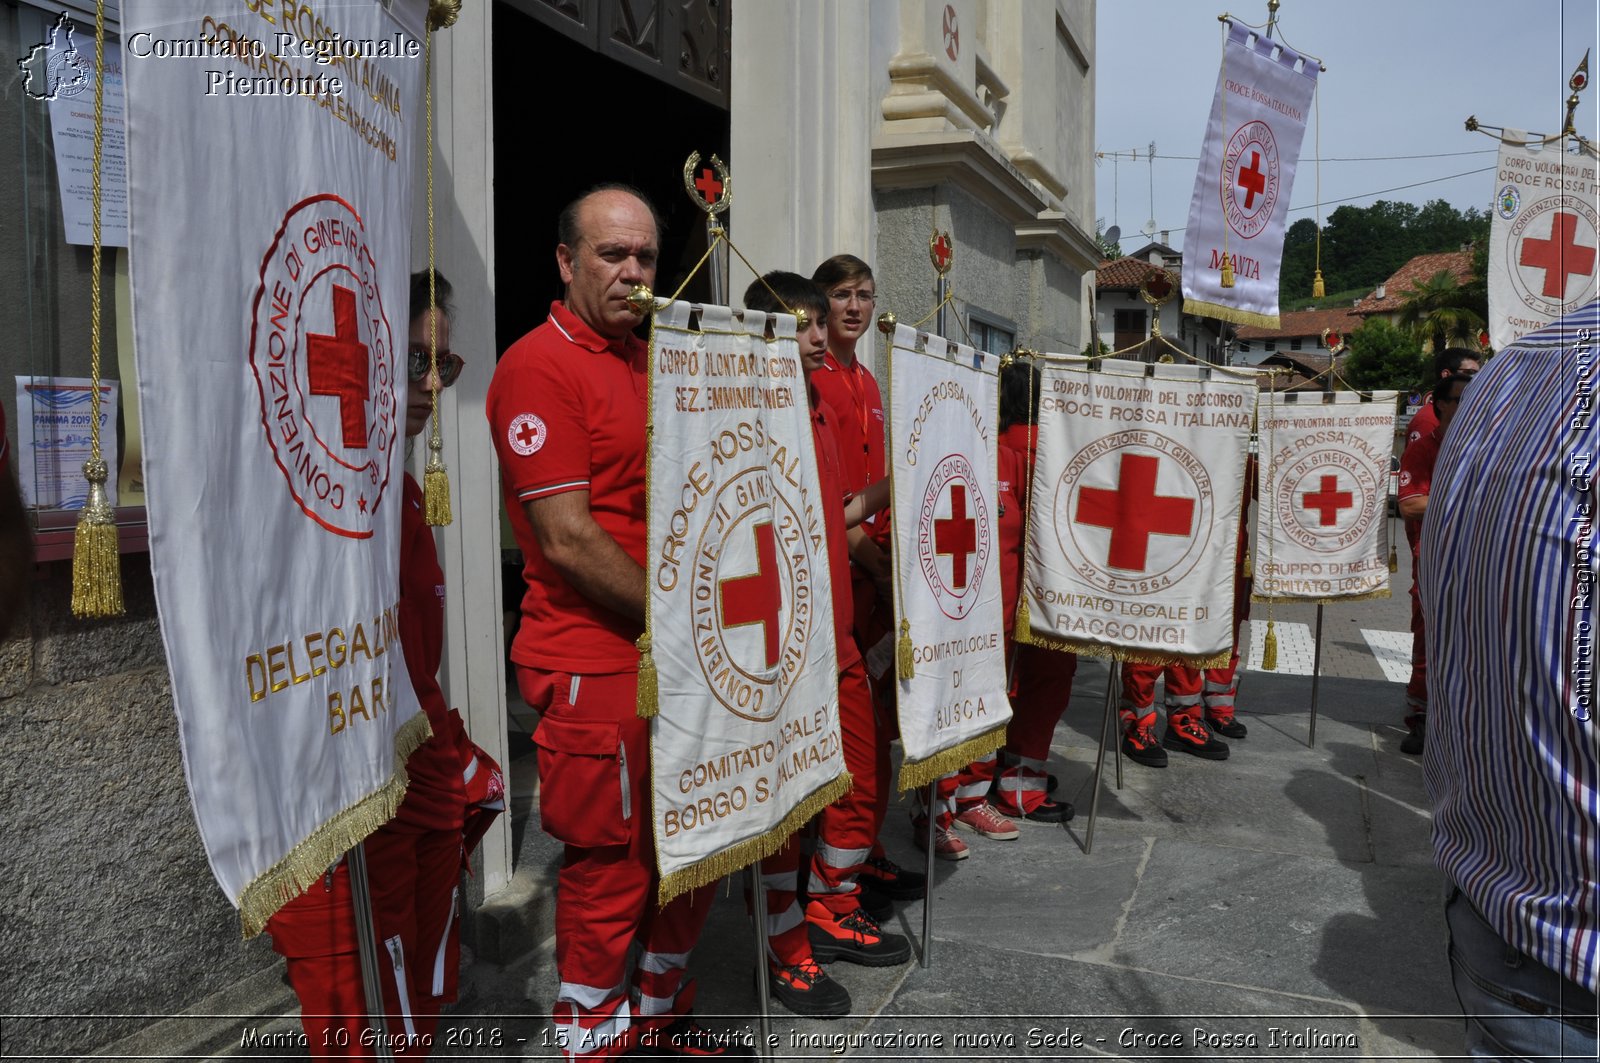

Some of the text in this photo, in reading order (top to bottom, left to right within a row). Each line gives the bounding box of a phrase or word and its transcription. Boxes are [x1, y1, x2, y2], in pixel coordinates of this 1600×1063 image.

[1225, 79, 1250, 98] CROCE
[1251, 89, 1271, 107] ROSSA
[1499, 170, 1541, 187] CROCE
[1545, 177, 1585, 193] ROSSA
[1505, 157, 1531, 171] CORPO
[1581, 168, 1596, 180] DEL
[285, 243, 304, 282] DI
[304, 219, 363, 270] GINEVRA
[1208, 249, 1259, 280] MANTA
[660, 347, 699, 377] CORPO
[675, 386, 705, 413] SEZ.
[1053, 379, 1243, 409] CORPO VOLONTARI DEL SOCCORSO
[71, 415, 91, 424] 2019
[907, 394, 933, 466] CROCE
[932, 381, 965, 405] ROSSA
[1041, 397, 1250, 429] CROCE ROSSA ITALIANA
[1264, 416, 1392, 430] CORPO VOLONTARI DEL SOCCORSO
[1295, 431, 1345, 452] ROSSA
[1063, 432, 1211, 500] CONVENZIONE DI GINEVRA
[1296, 462, 1307, 475] DI
[1311, 453, 1358, 472] GINEVRA
[657, 461, 714, 592] CROCE
[920, 485, 942, 598] CONVENZIONE
[943, 460, 971, 480] GINEVRA
[976, 497, 988, 561] AGOSTO
[779, 516, 800, 548] 22
[792, 554, 809, 643] AGOSTO
[1261, 557, 1383, 576] GRUPPO DI MELLE
[1263, 575, 1382, 592] COMITATO LOCALE
[1121, 601, 1188, 621] LOCALE
[1195, 606, 1209, 621] DI
[1056, 613, 1186, 644] RACCONIGI
[953, 669, 963, 688] DI
[937, 697, 986, 730] BUSCA
[679, 739, 776, 794] COMITATO
[664, 785, 747, 837] BORGO
[755, 777, 774, 803] S.
